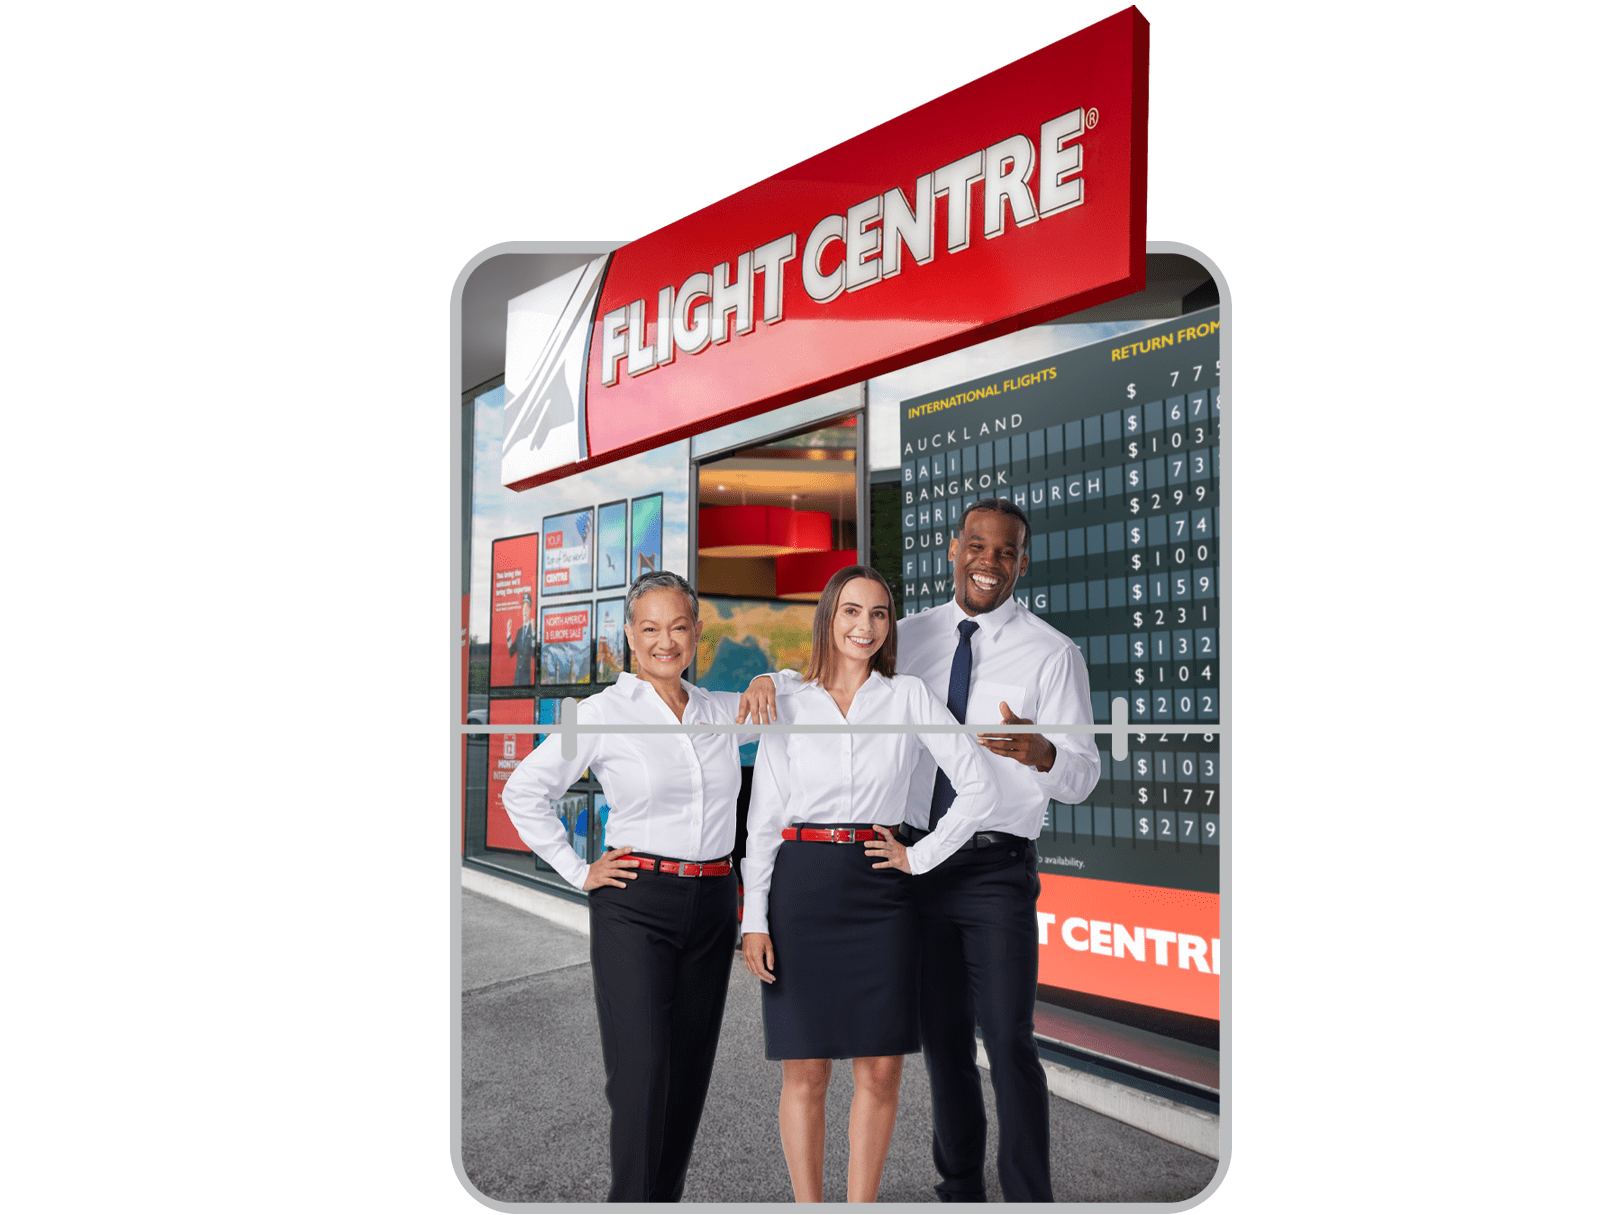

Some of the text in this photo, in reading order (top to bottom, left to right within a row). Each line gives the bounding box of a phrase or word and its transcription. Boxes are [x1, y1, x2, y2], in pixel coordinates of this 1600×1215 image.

[601, 232, 797, 387] FLIGHT
[801, 107, 1085, 304] CENTRE
[1111, 319, 1220, 362] RETURN FROM
[908, 366, 1057, 419] INTERNATIONAL FLIGHTS
[904, 413, 1023, 455] AUCKLAND
[1128, 423, 1220, 459] $103
[905, 458, 955, 482] BALI
[905, 471, 1007, 504] BANGKOK
[905, 478, 1100, 527] CHRIHURCH
[906, 557, 955, 575] FIJ
[546, 572, 568, 583] CENTRE
[1132, 576, 1209, 600] $159
[546, 614, 587, 626] NORTH AMERICA
[1134, 636, 1212, 658] $132
[1135, 665, 1212, 685] $104
[1135, 696, 1213, 715] $202
[1137, 758, 1214, 776] $103
[1138, 787, 1215, 806] $177
[1139, 817, 1216, 838] $279
[1044, 855, 1085, 870] availability.
